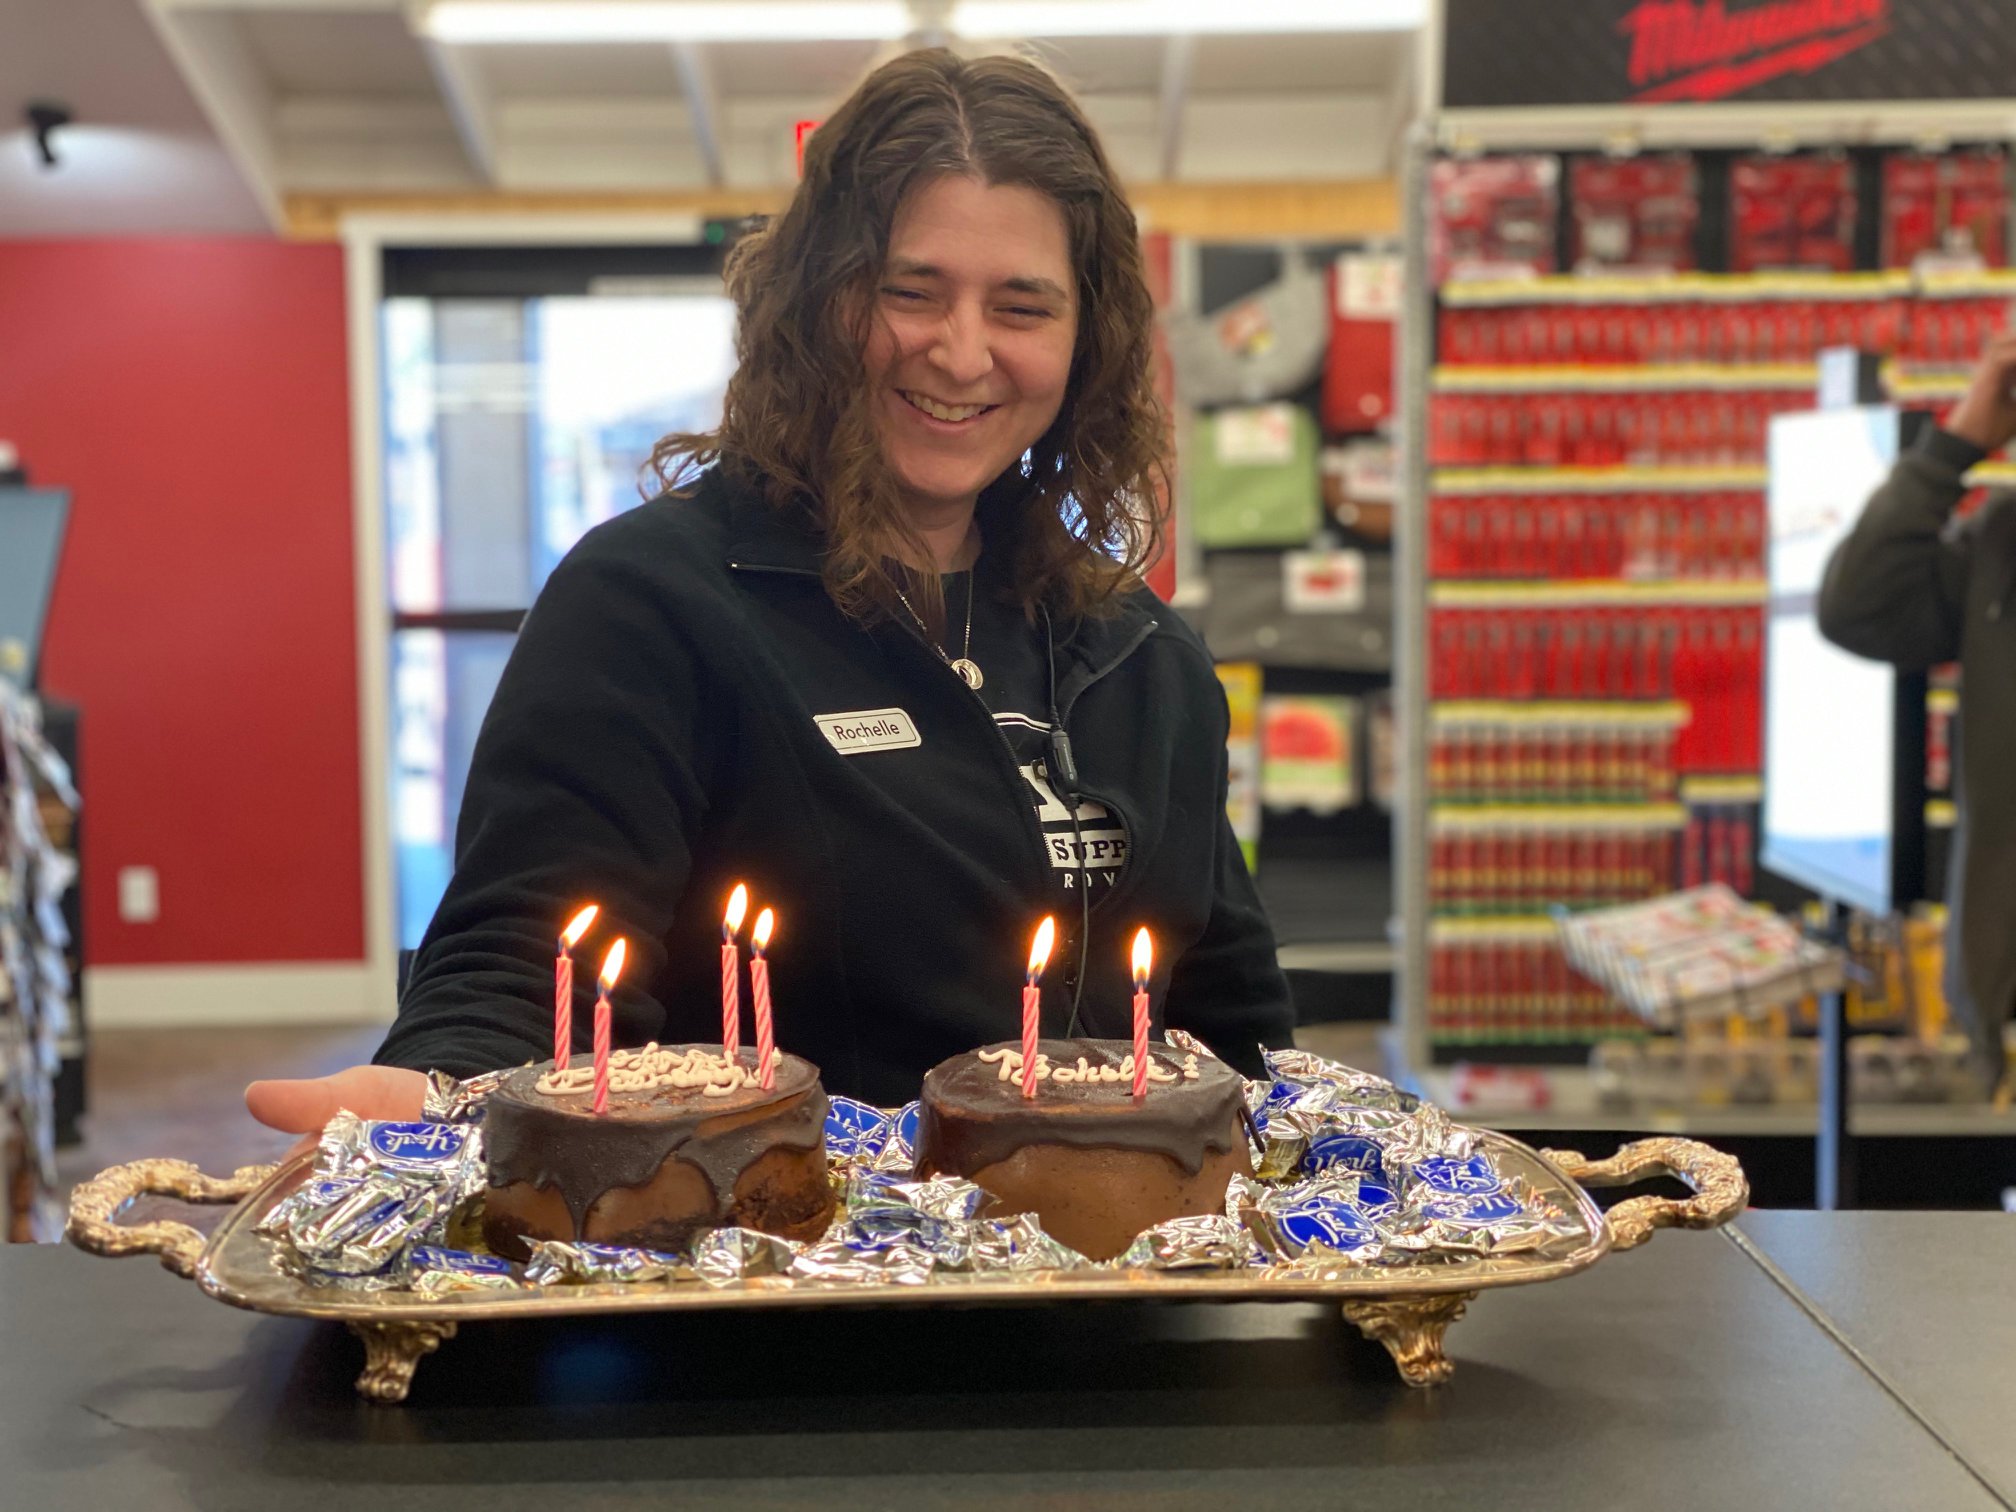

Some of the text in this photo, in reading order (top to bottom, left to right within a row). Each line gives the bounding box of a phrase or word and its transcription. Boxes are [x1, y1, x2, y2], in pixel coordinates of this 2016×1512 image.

[833, 720, 900, 740] Rochelle
[385, 1123, 461, 1153] York
[1304, 1148, 1378, 1173] York
